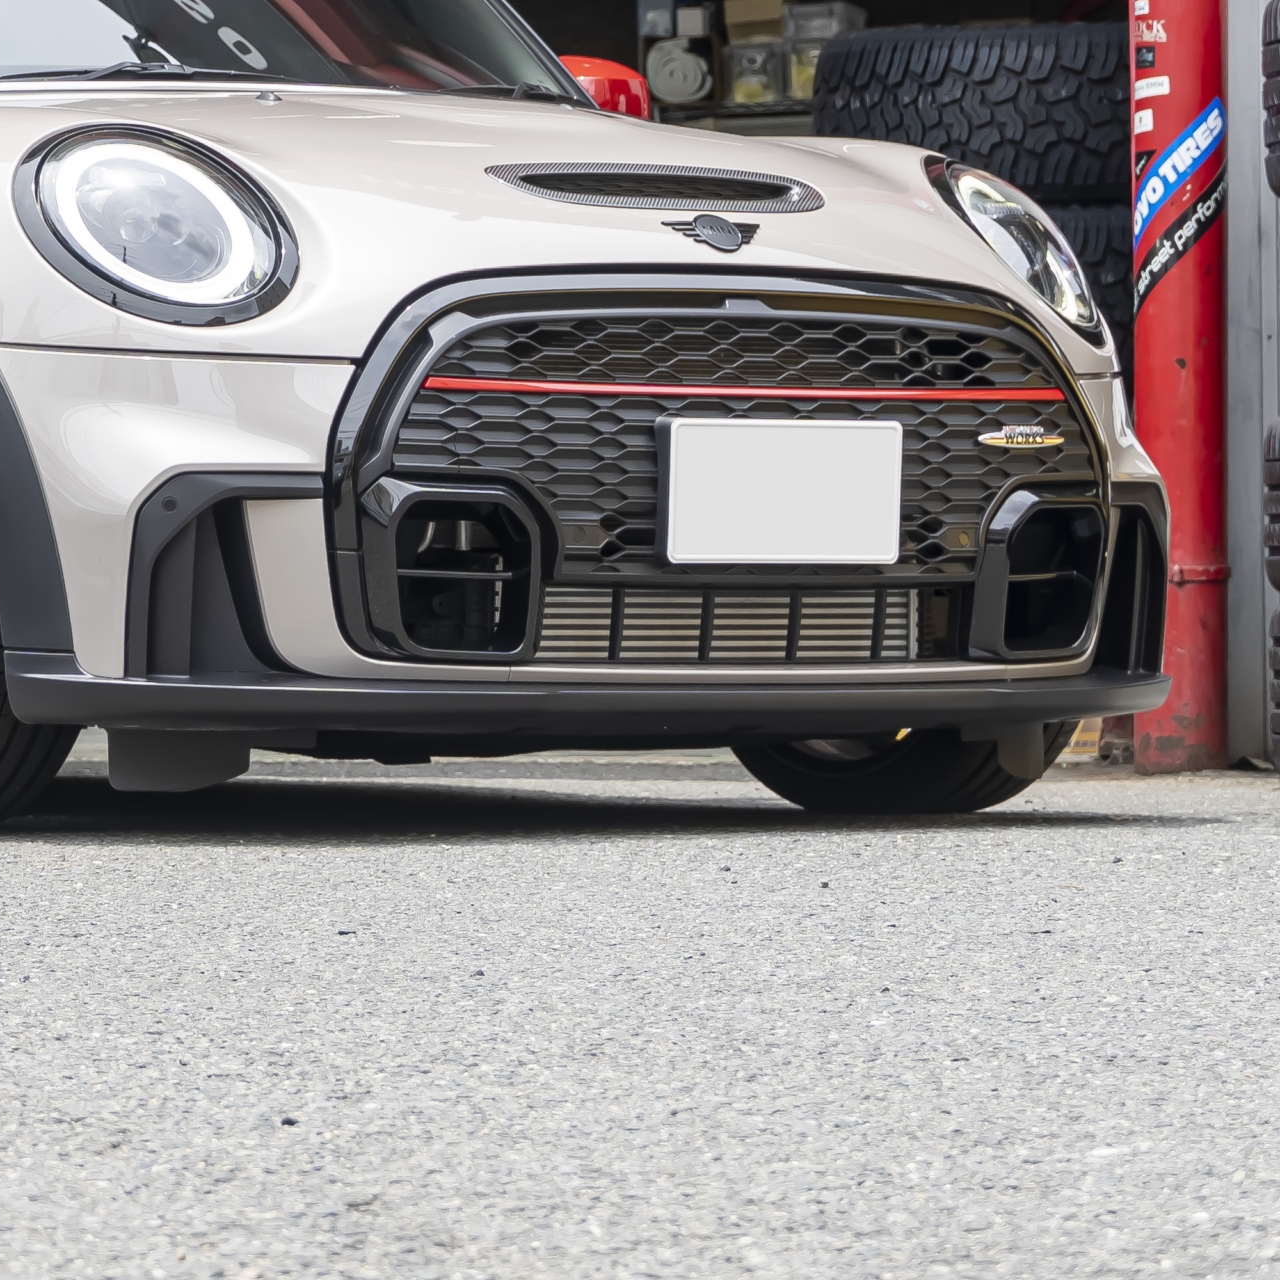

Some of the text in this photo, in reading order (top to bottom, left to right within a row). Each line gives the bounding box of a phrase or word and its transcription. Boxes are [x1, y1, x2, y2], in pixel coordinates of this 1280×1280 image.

[1158, 108, 1224, 185] TIRES
[701, 224, 738, 236] MINI
[1137, 172, 1228, 296] street perform
[1005, 433, 1044, 444] WORKS
